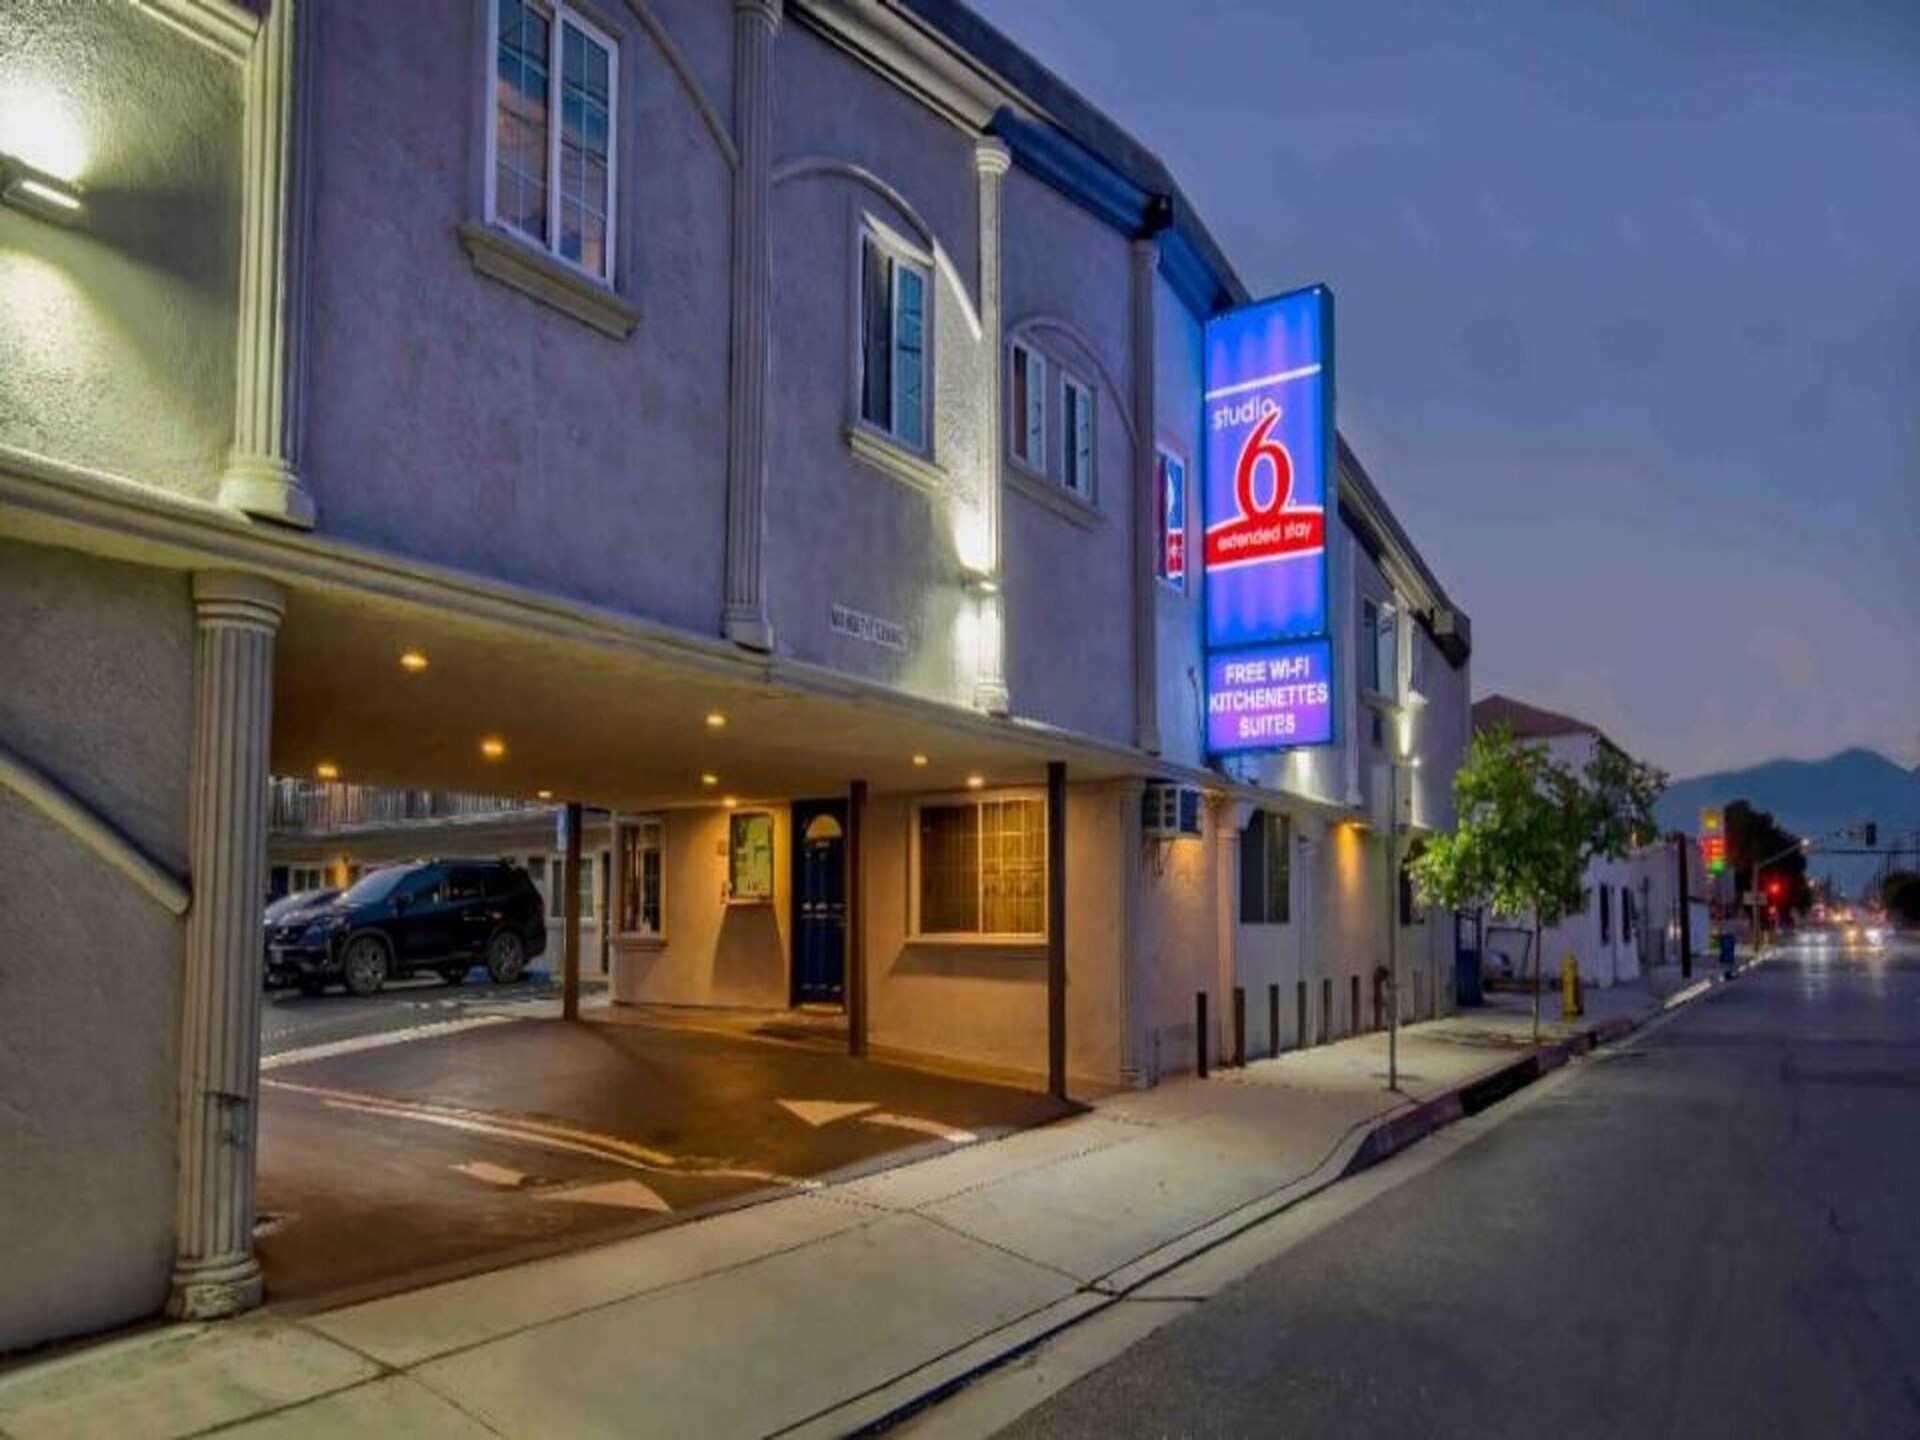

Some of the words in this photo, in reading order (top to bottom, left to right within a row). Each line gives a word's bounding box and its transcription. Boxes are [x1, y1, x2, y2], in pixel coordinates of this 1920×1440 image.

[1213, 395, 1277, 430] studio
[1234, 405, 1294, 520] 6
[1216, 524, 1281, 551] extended
[1284, 521, 1312, 543] stay
[1225, 661, 1267, 685] FREE
[1269, 656, 1310, 680] WI-FI
[1209, 682, 1328, 714] KITCHENETTES
[1240, 714, 1295, 737] SUITES
